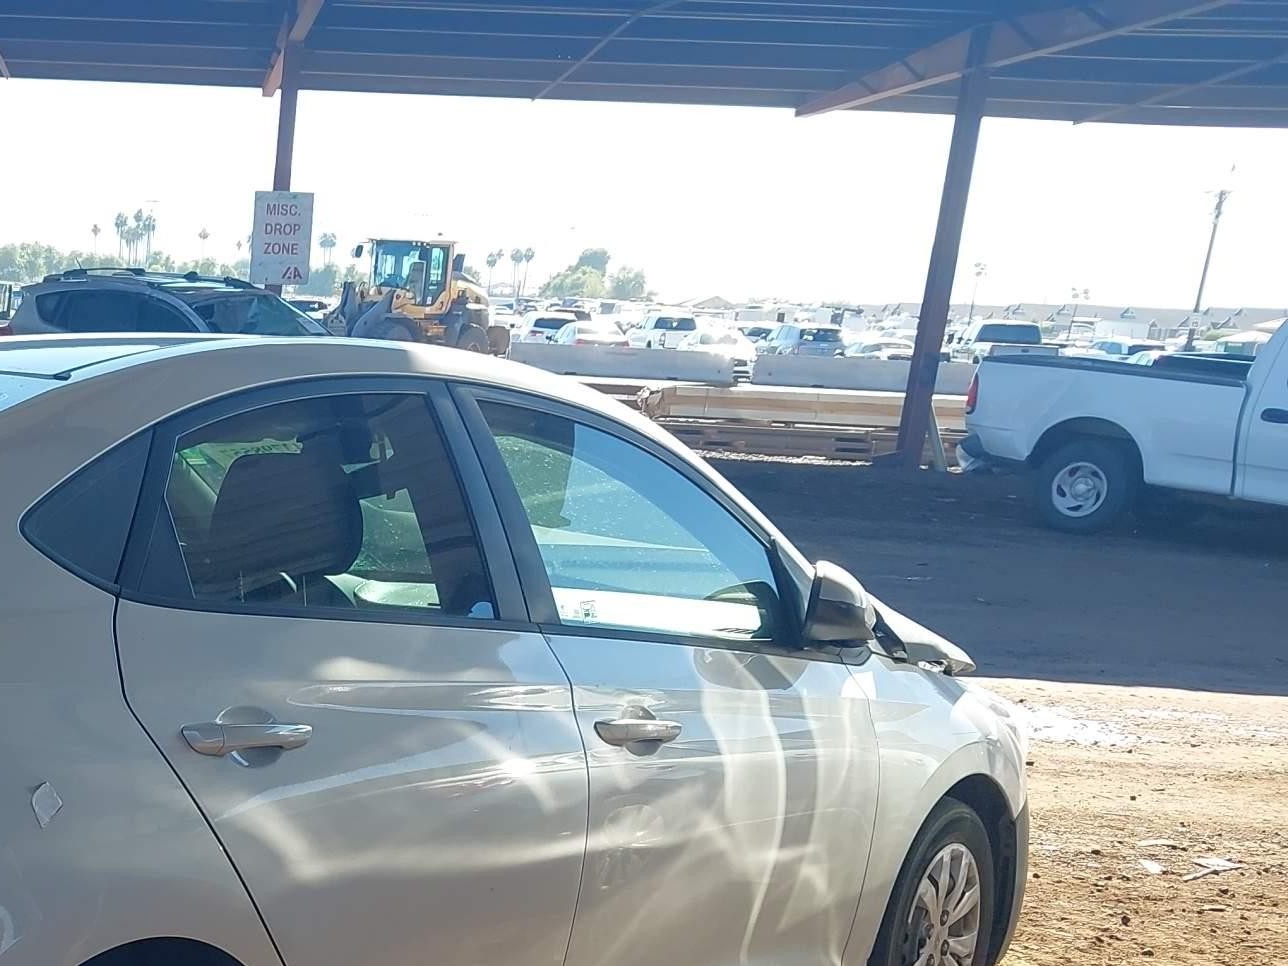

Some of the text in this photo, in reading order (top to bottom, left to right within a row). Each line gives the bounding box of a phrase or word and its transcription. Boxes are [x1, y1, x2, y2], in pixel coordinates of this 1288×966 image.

[266, 203, 301, 217] MISC.
[264, 223, 301, 236] DROP
[264, 242, 299, 255] ZONE
